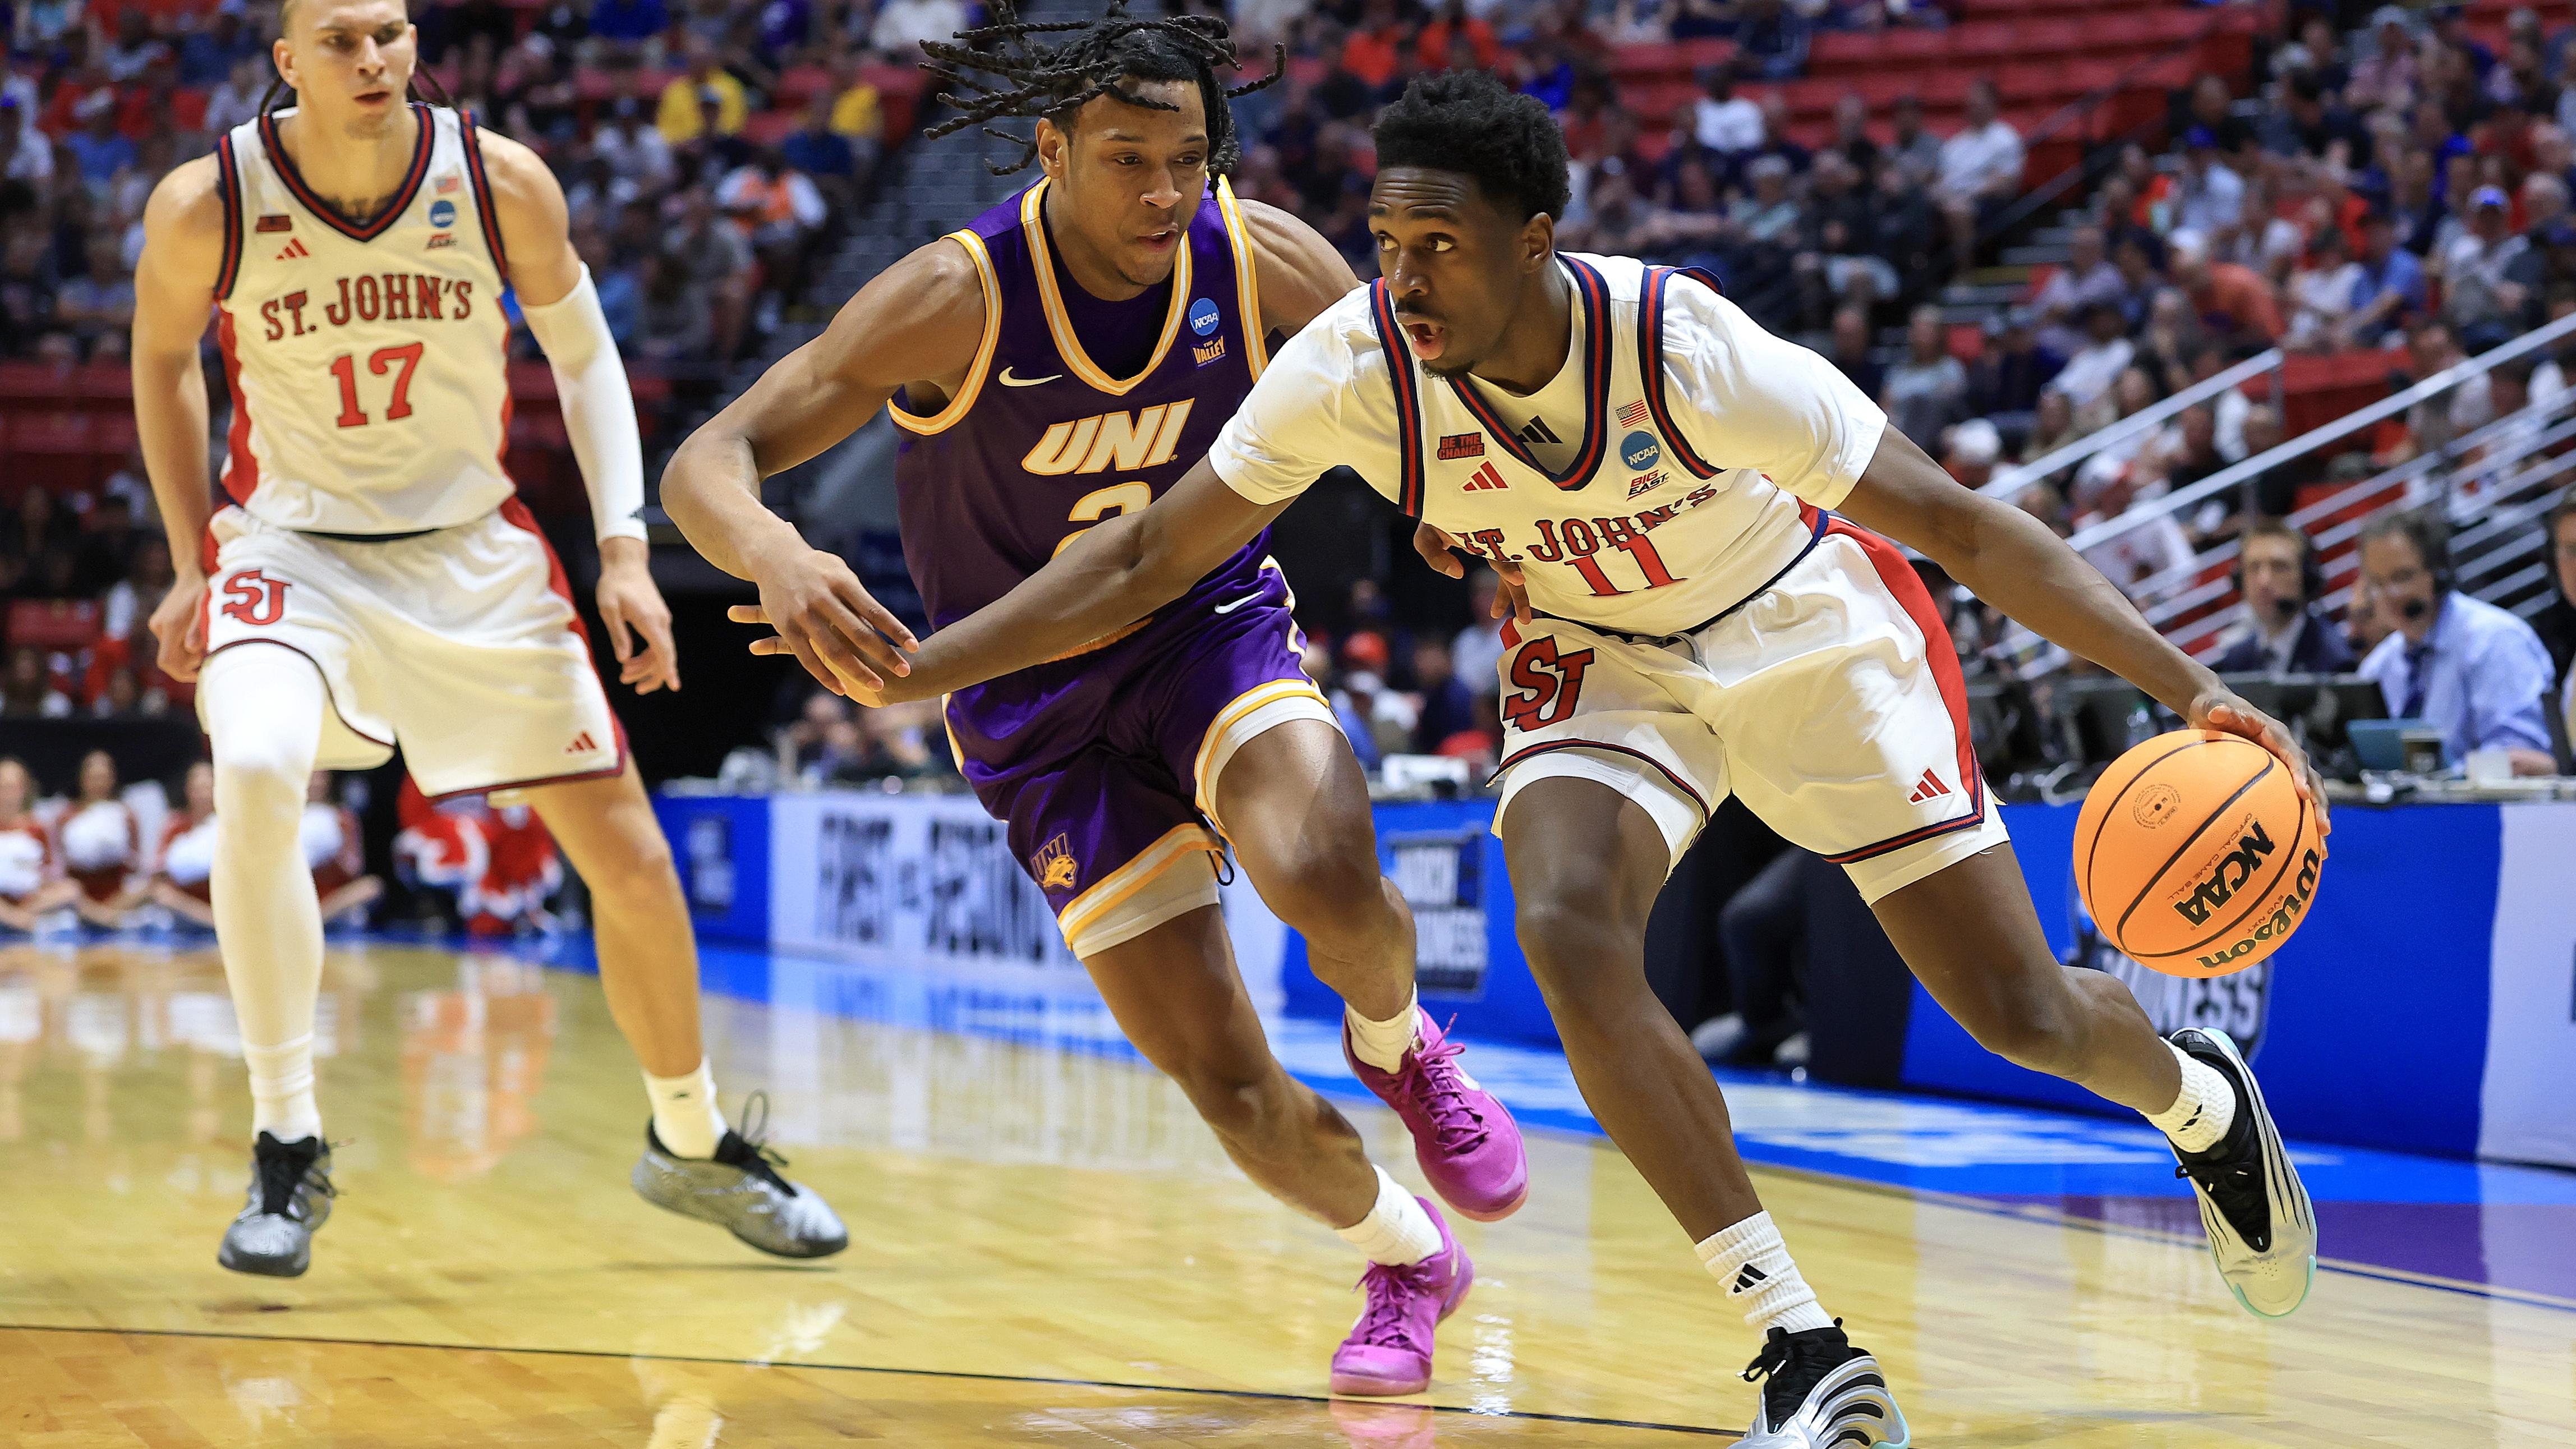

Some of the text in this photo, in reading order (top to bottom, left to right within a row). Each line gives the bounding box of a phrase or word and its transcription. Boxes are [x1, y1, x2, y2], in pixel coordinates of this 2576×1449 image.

[261, 273, 472, 341] ST. JOHN'S
[1194, 312, 1219, 329] NCAA
[1192, 335, 1225, 364] VALLEY
[330, 342, 424, 428] 17
[1022, 398, 1195, 475] UNI
[1438, 444, 1484, 459] CHANGE
[1441, 434, 1480, 449] BE THE
[1628, 444, 1659, 466] NCAA
[1628, 472, 1669, 496] EAST
[1630, 470, 1659, 488] BIG
[1526, 484, 1717, 562] JOHN'S
[1564, 534, 1689, 596] 11
[222, 569, 291, 625] SJ
[1502, 634, 1594, 733] SJ
[1030, 832, 1068, 884] UNI
[2167, 813, 2252, 900] OFFICIAL GAME BALL
[2172, 820, 2275, 928] NCAA
[2247, 894, 2285, 933] EVO NXT
